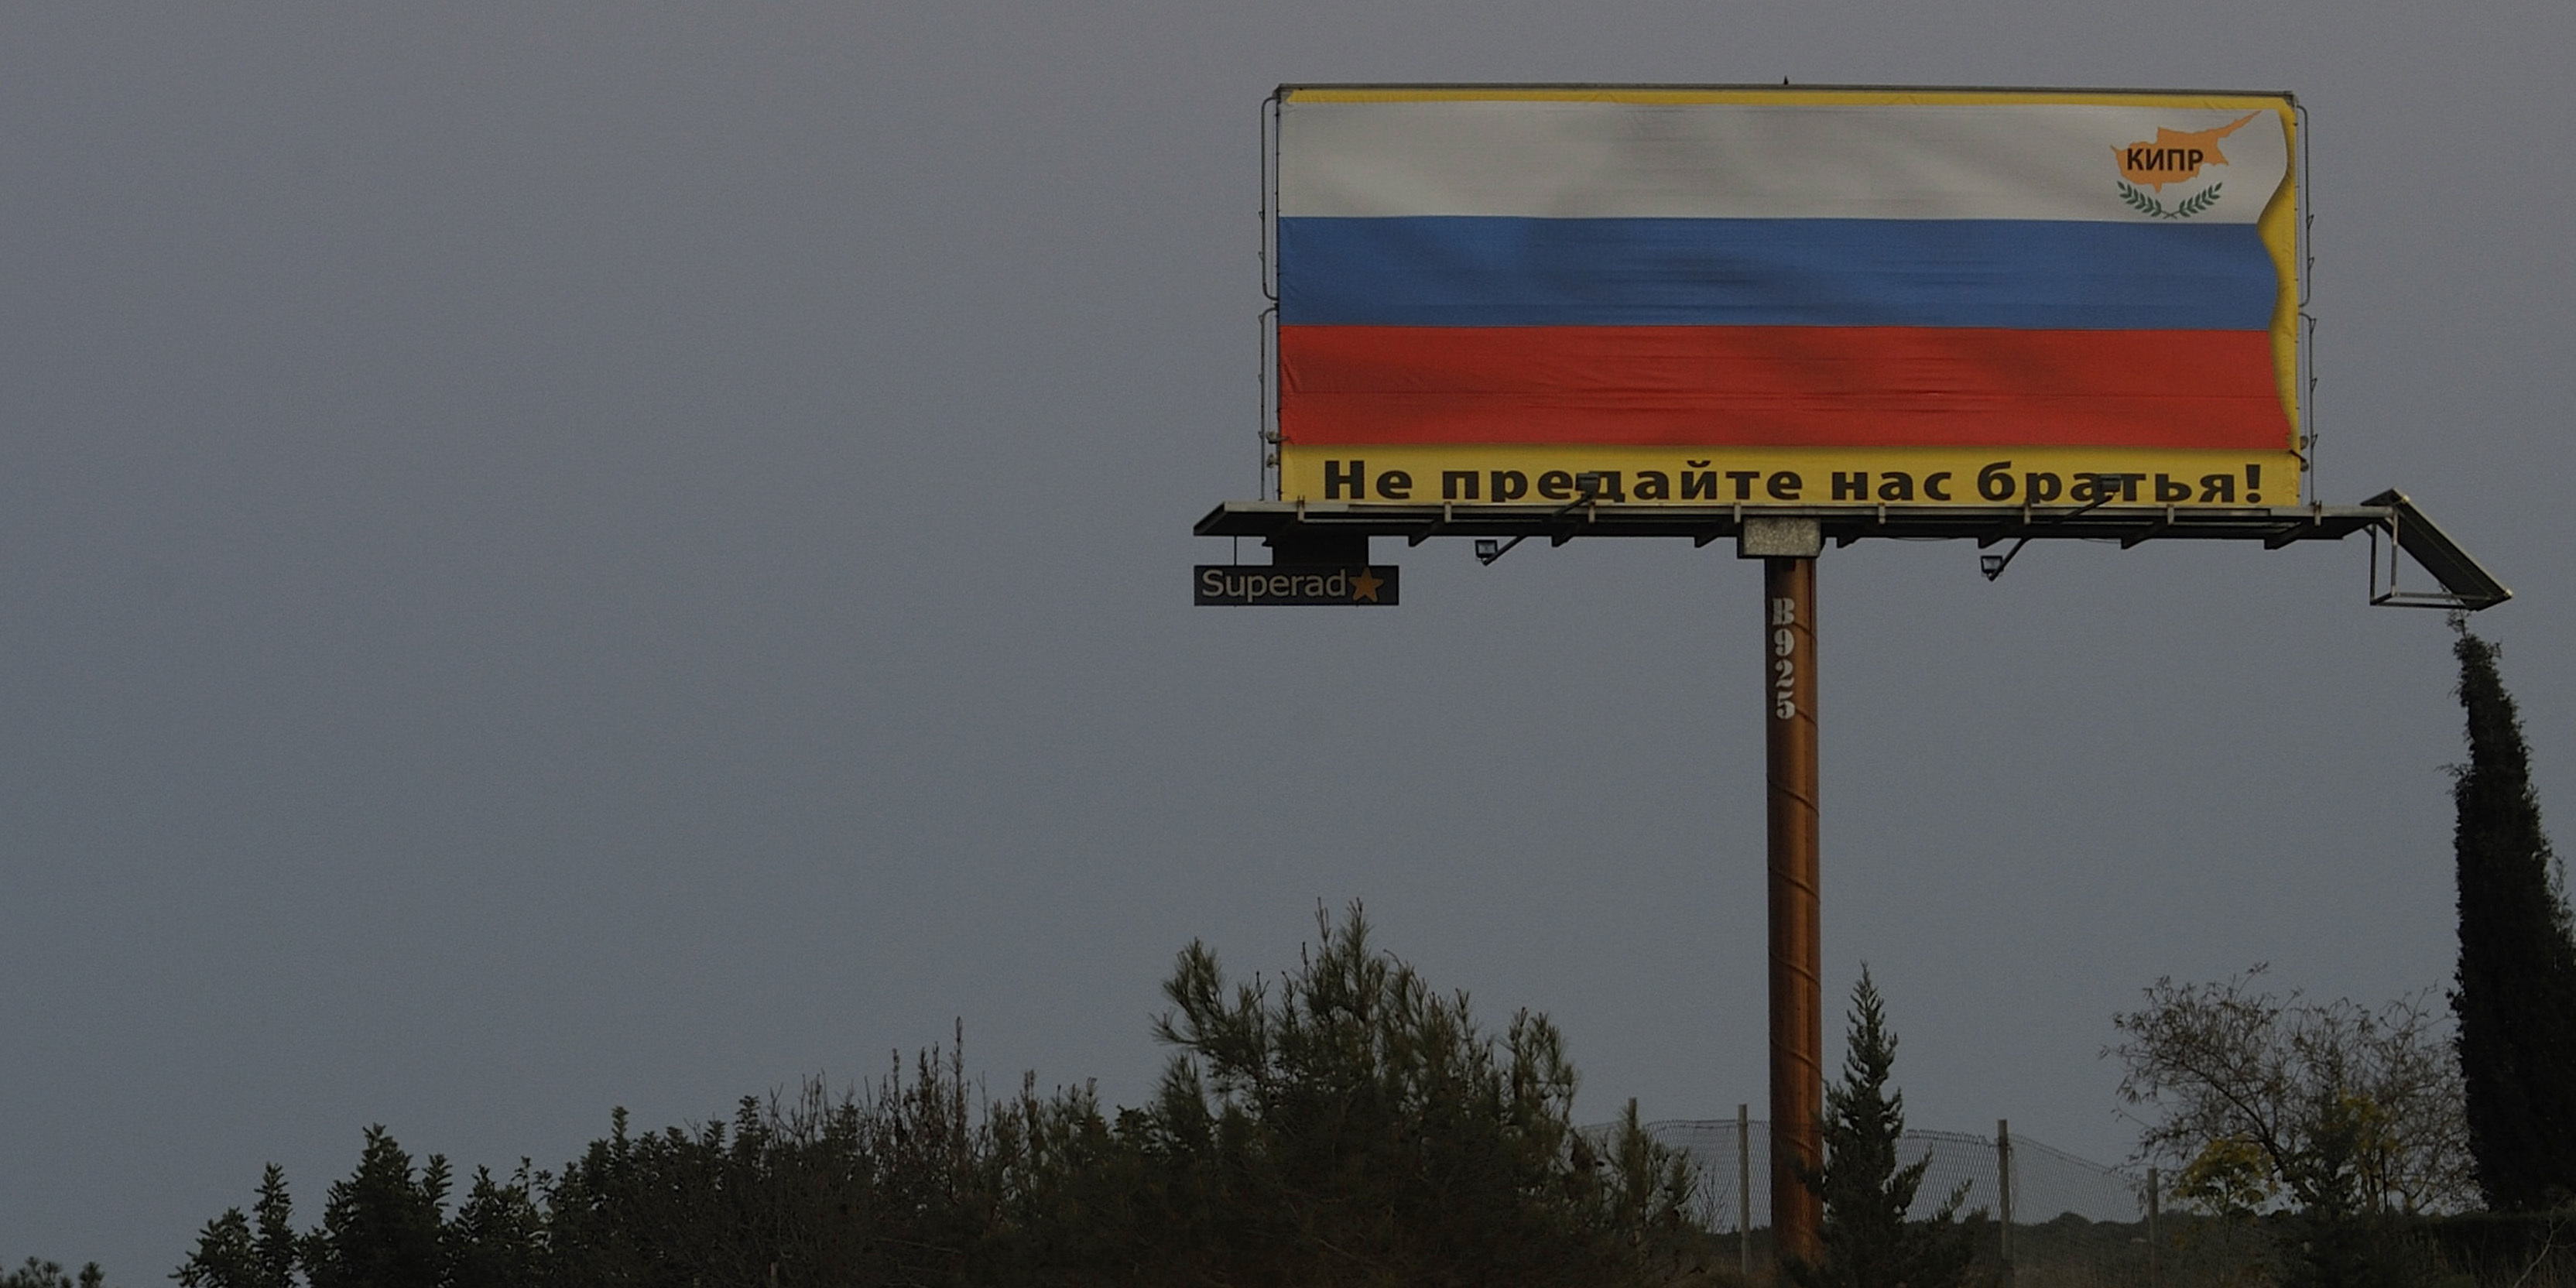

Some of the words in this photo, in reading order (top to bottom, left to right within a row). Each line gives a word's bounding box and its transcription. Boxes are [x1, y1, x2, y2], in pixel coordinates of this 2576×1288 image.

[2127, 148, 2204, 171] КИПР
[1324, 461, 1413, 500] Не
[1442, 460, 1804, 503] предайте
[1831, 471, 1952, 502] нас
[1977, 461, 2263, 503] братья!
[1202, 569, 1347, 603] Superad
[1772, 598, 1796, 719] B925
